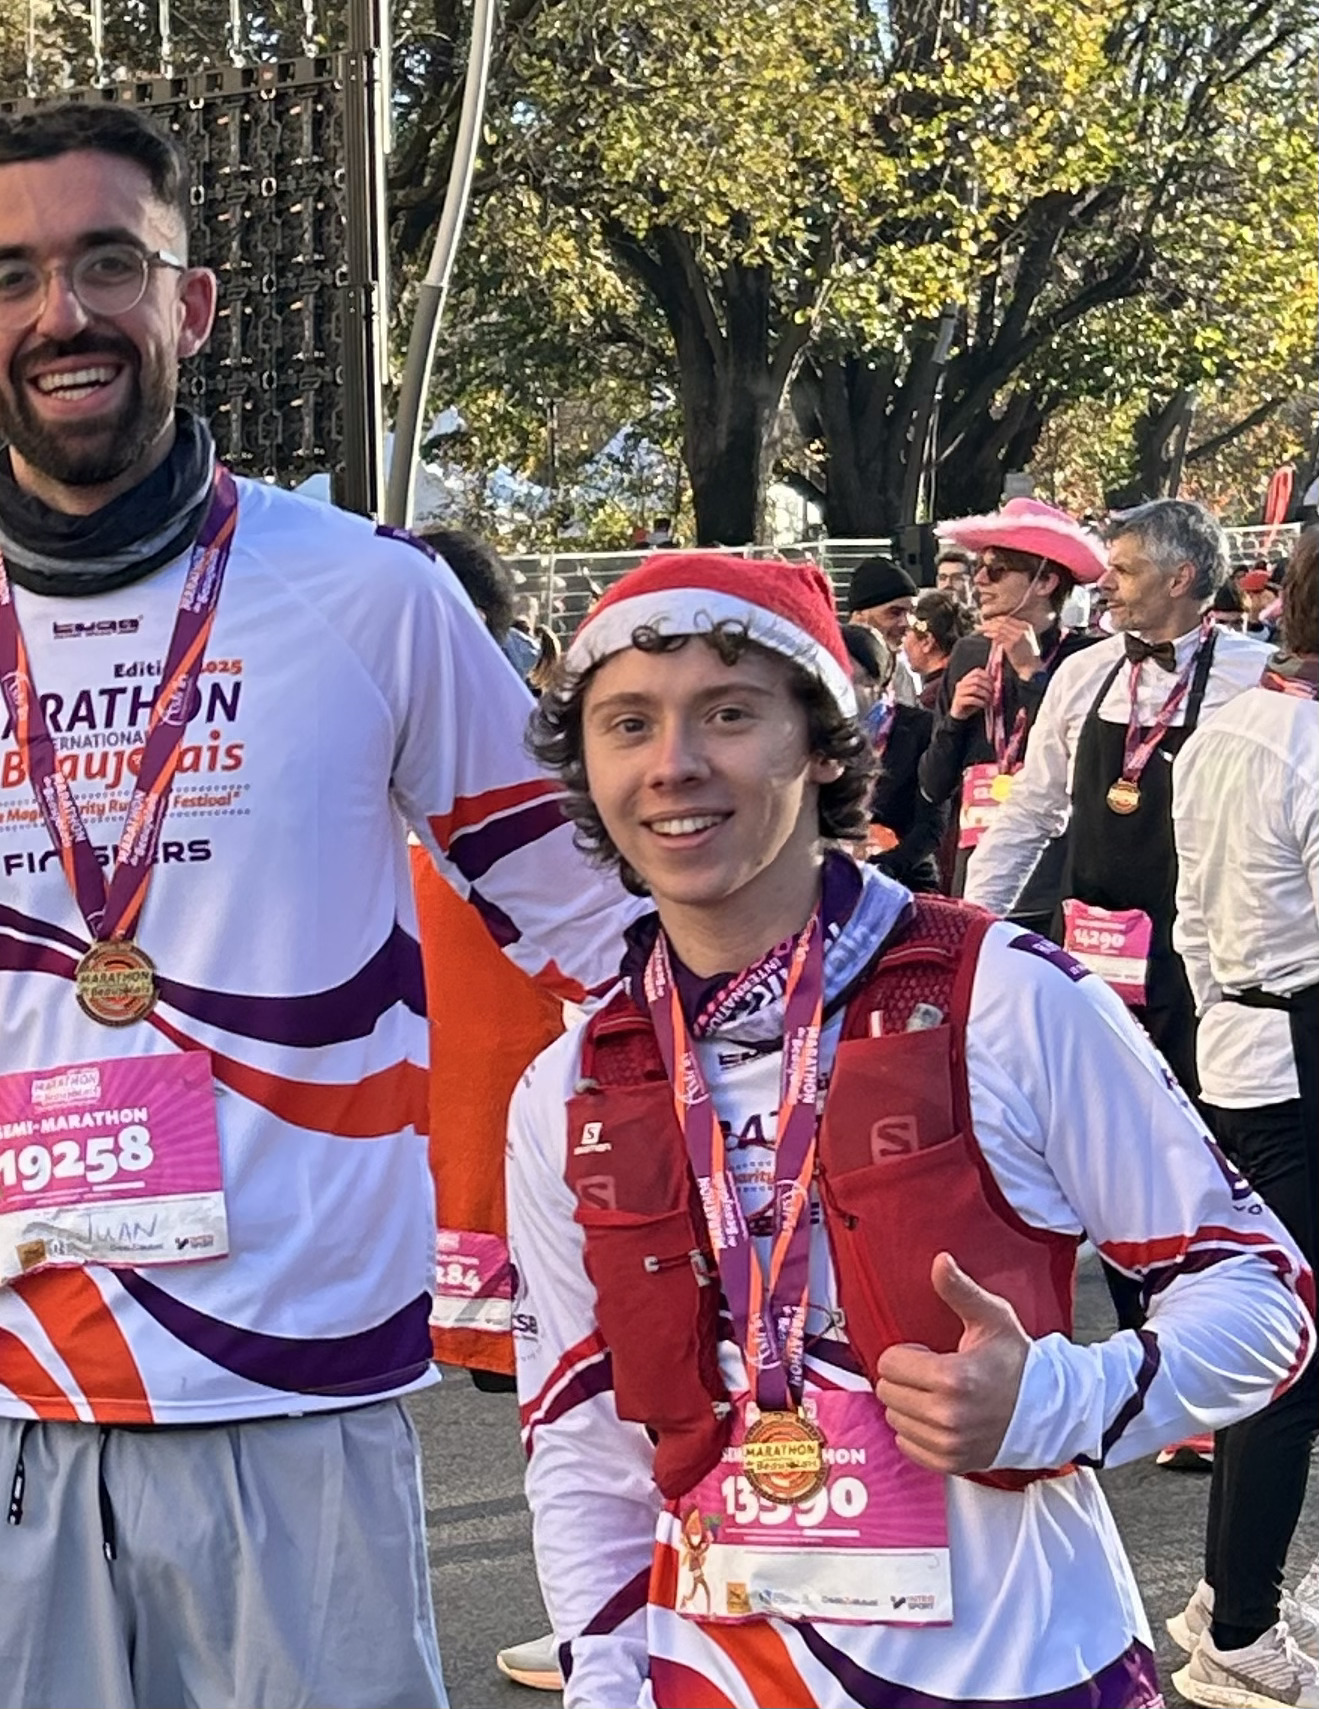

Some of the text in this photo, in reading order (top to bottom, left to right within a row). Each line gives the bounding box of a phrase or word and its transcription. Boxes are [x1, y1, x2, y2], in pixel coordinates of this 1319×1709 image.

[114, 660, 243, 678] Editi 025
[53, 731, 145, 751] ERNATIONA
[1, 730, 245, 788] Baujoais
[80, 799, 106, 816] rity
[3, 839, 212, 876] FINSRS
[803, 1027, 818, 1103] MARATHON
[736, 1169, 772, 1186] arity
[746, 1444, 815, 1457] MARATHON
